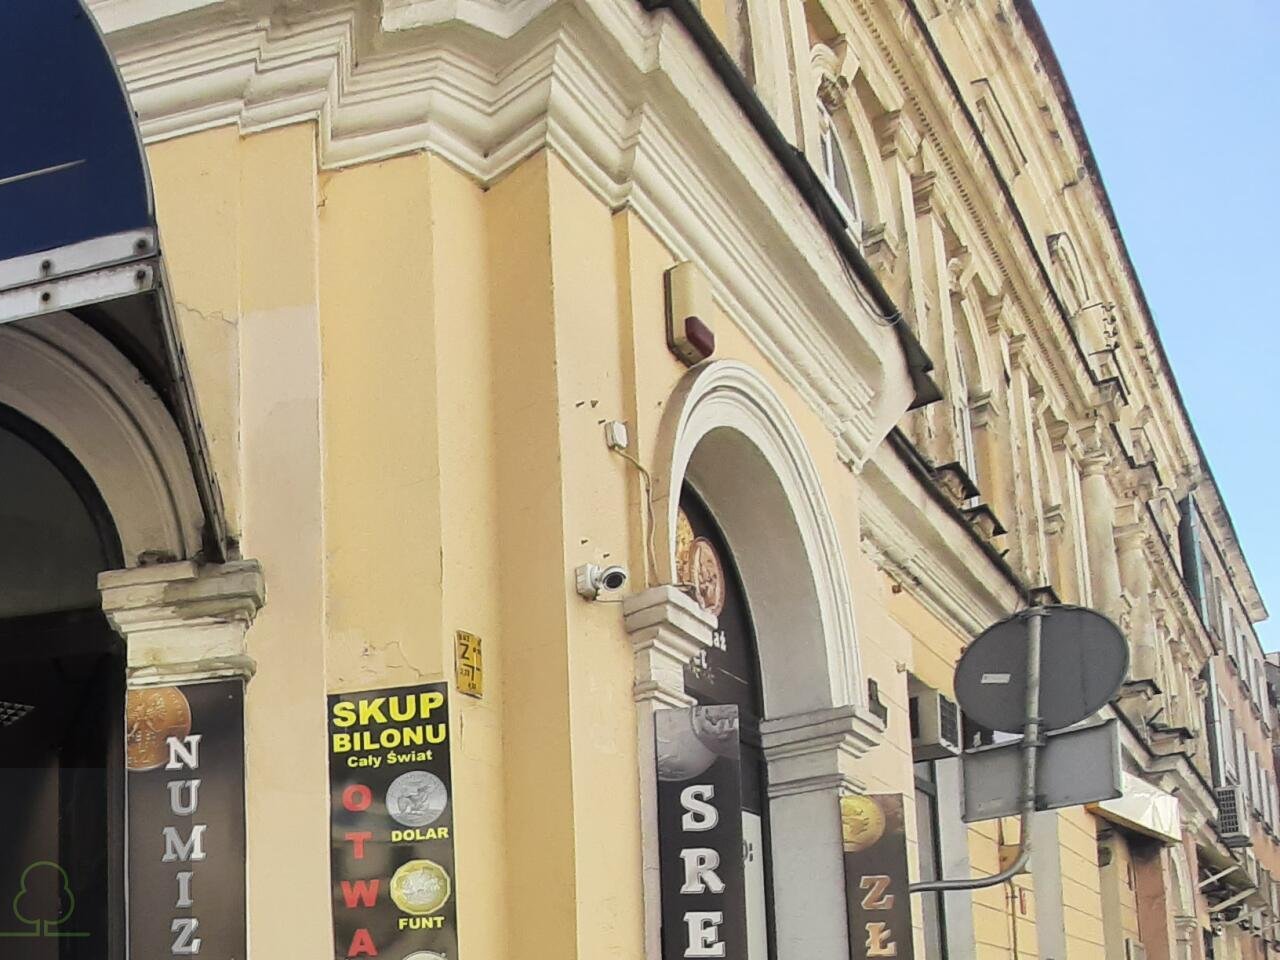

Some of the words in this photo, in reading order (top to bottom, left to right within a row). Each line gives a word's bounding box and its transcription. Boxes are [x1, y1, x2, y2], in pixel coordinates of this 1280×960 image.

[332, 691, 444, 727] SKUP
[332, 723, 446, 753] BILONU
[387, 749, 433, 764] Świat
[391, 827, 449, 842] DOLAR
[398, 916, 445, 930] FUNT
